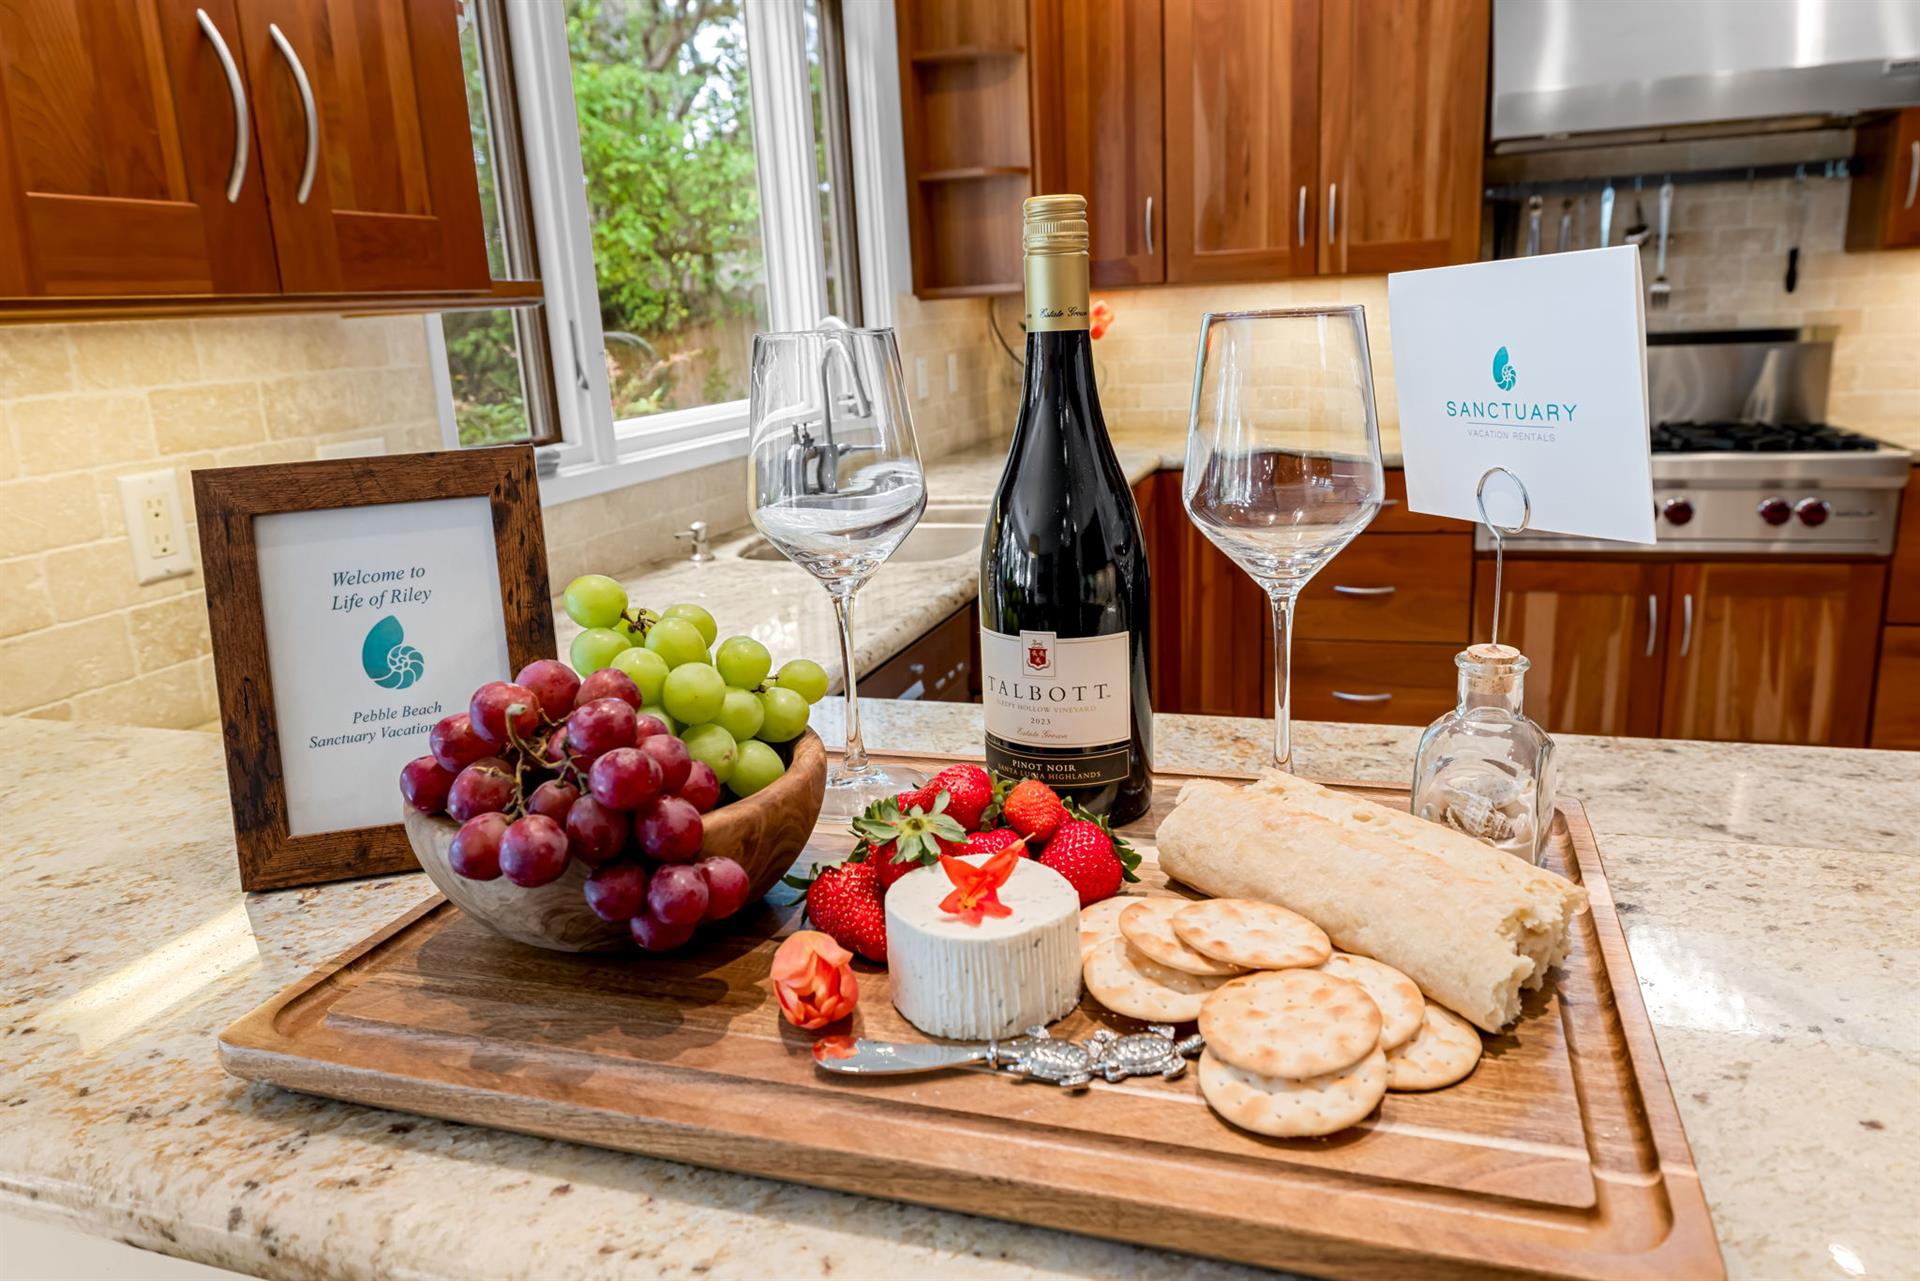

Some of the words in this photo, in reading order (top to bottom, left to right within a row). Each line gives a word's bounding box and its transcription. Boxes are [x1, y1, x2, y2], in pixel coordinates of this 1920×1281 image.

[1446, 400, 1577, 422] SANCTUARY
[1467, 429, 1509, 440] VACATION
[1512, 432, 1556, 443] RENTALS
[333, 569, 405, 586] Welcome
[410, 566, 426, 578] to
[332, 593, 364, 613] Life
[369, 590, 388, 609] of
[391, 587, 432, 604] Riley
[988, 675, 1108, 702] TALBOTT
[352, 707, 398, 724] Pebble
[402, 701, 442, 717] Beach
[1017, 704, 1050, 713] HOLLOW
[1053, 705, 1097, 714] VINEYARD
[1030, 717, 1051, 726] 2023
[309, 731, 376, 749] Sanctuary
[1012, 760, 1042, 771] PINOT
[1047, 764, 1076, 772] NOIR
[1048, 771, 1101, 780] HIGHLANDS
